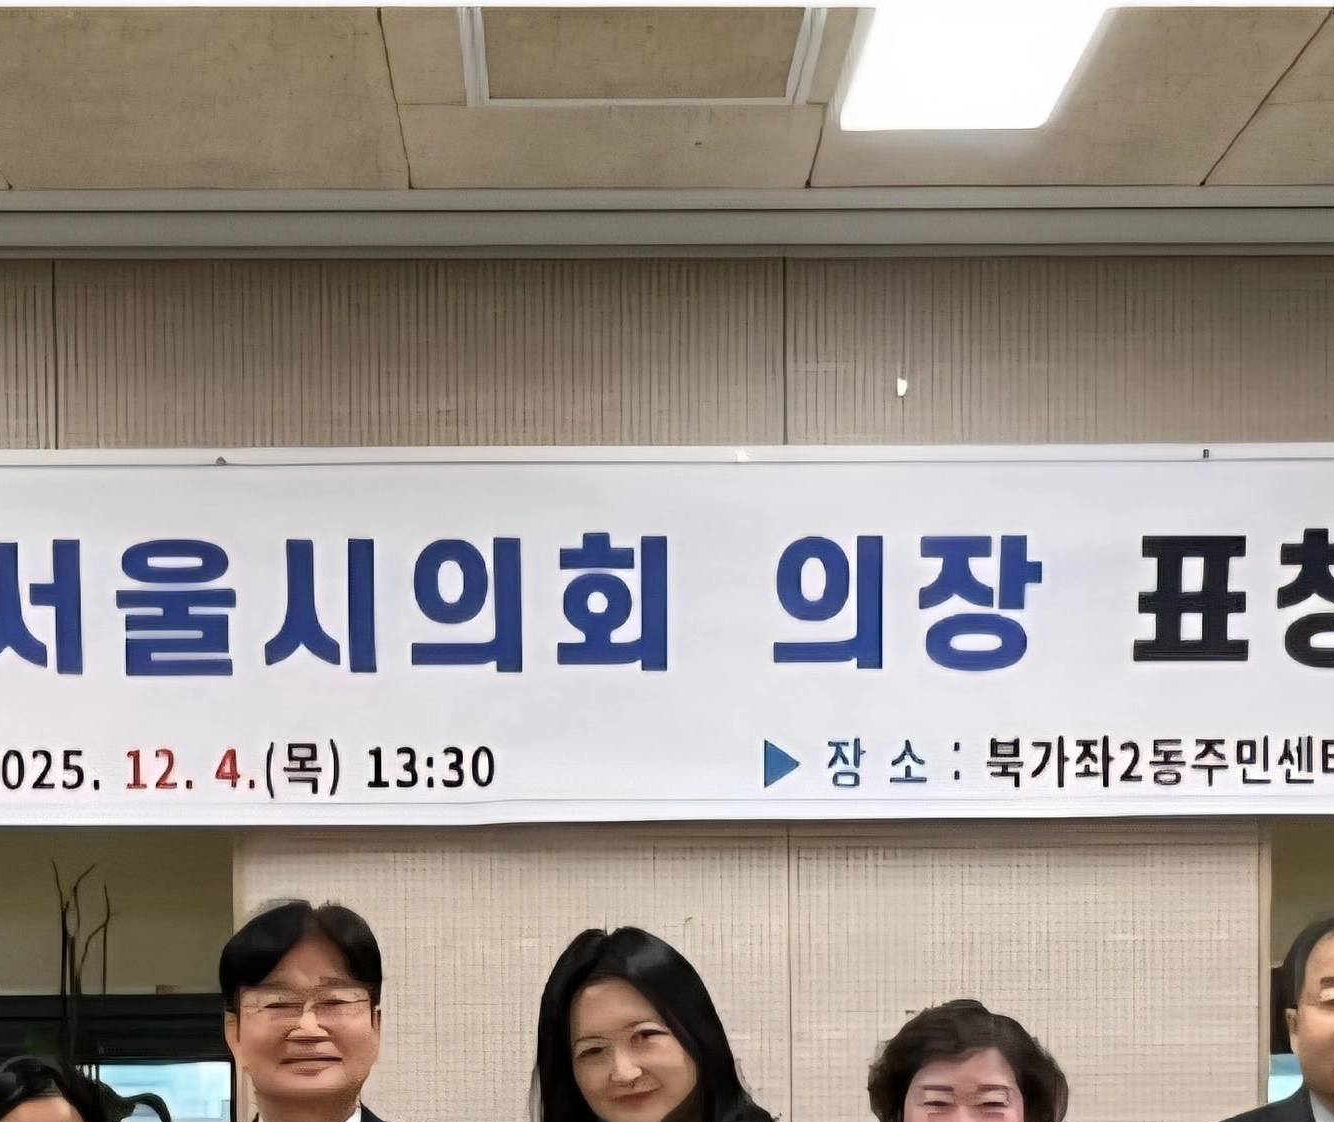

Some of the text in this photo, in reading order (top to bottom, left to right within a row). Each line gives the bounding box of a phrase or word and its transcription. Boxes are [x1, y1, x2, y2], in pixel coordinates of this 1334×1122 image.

[772, 534, 1043, 672] 의장
[125, 747, 195, 791] 12.
[366, 745, 497, 791] 13:30
